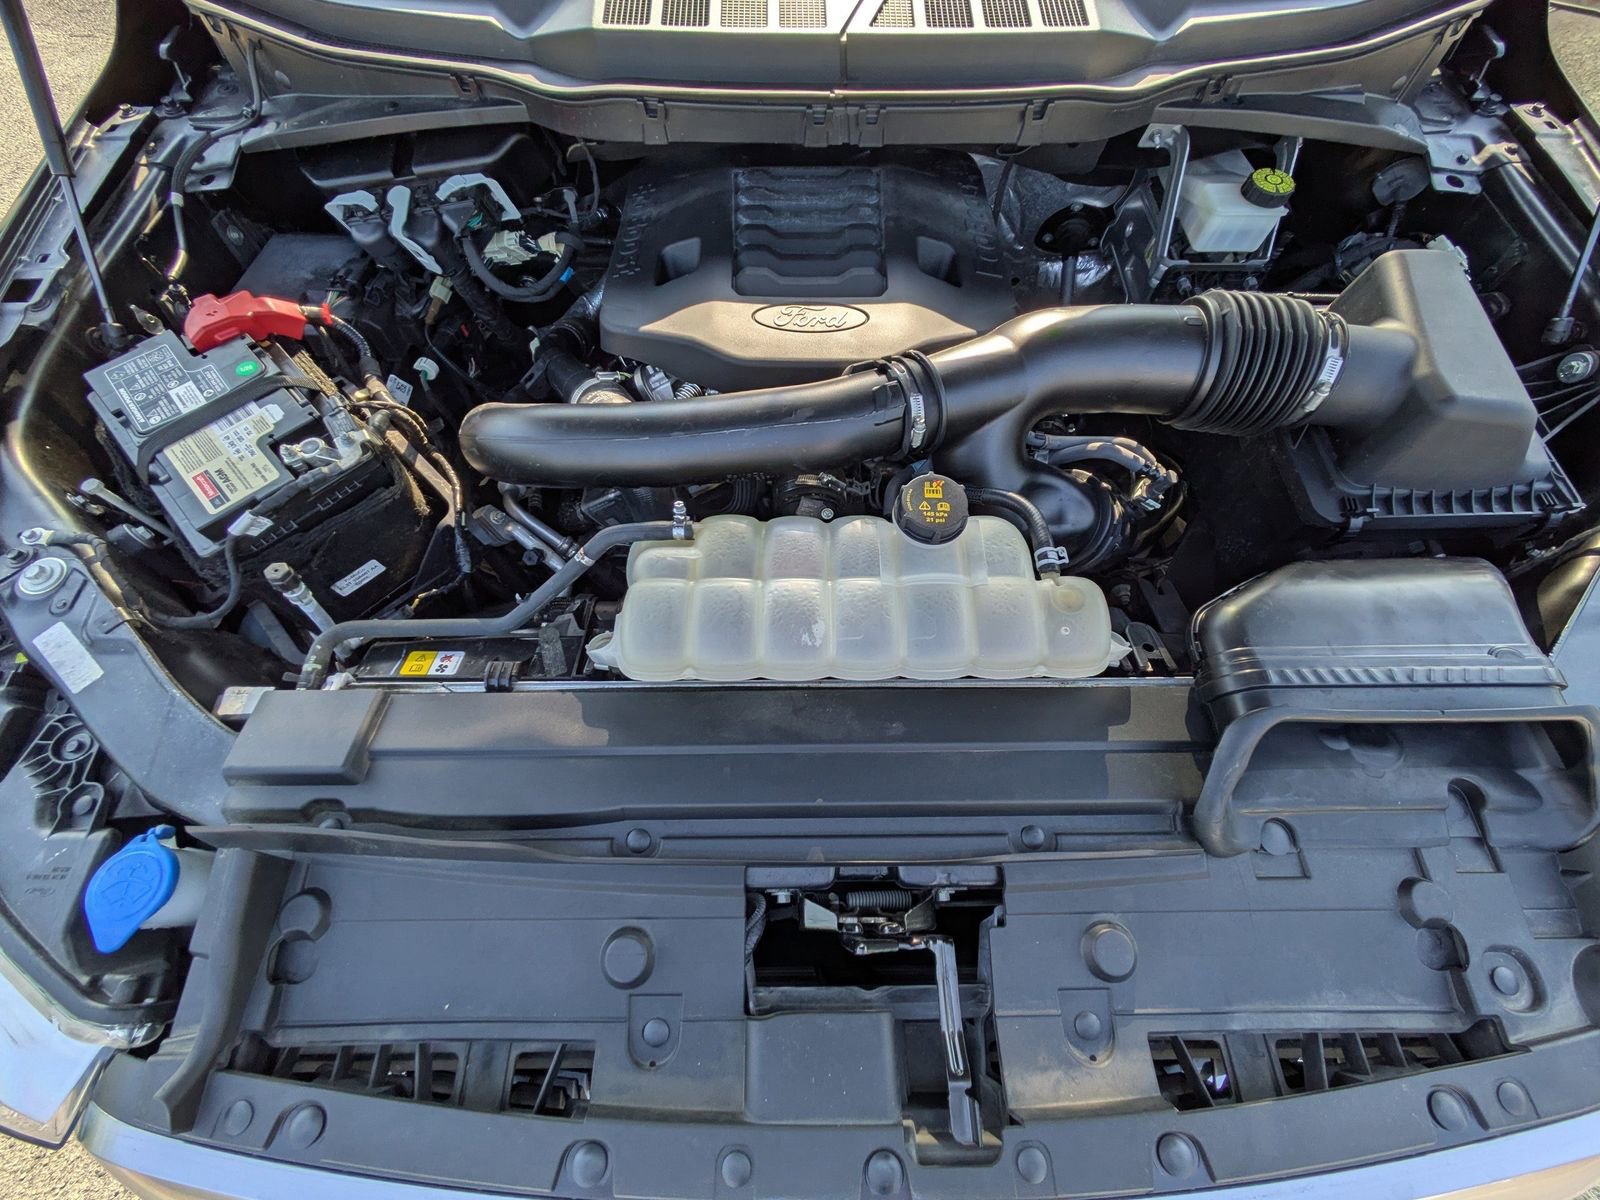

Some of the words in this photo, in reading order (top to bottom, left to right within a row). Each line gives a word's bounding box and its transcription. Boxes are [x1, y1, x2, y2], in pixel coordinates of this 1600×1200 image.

[773, 306, 849, 328] Ford
[194, 474, 215, 497] Motorcraft
[213, 466, 231, 484] AGM
